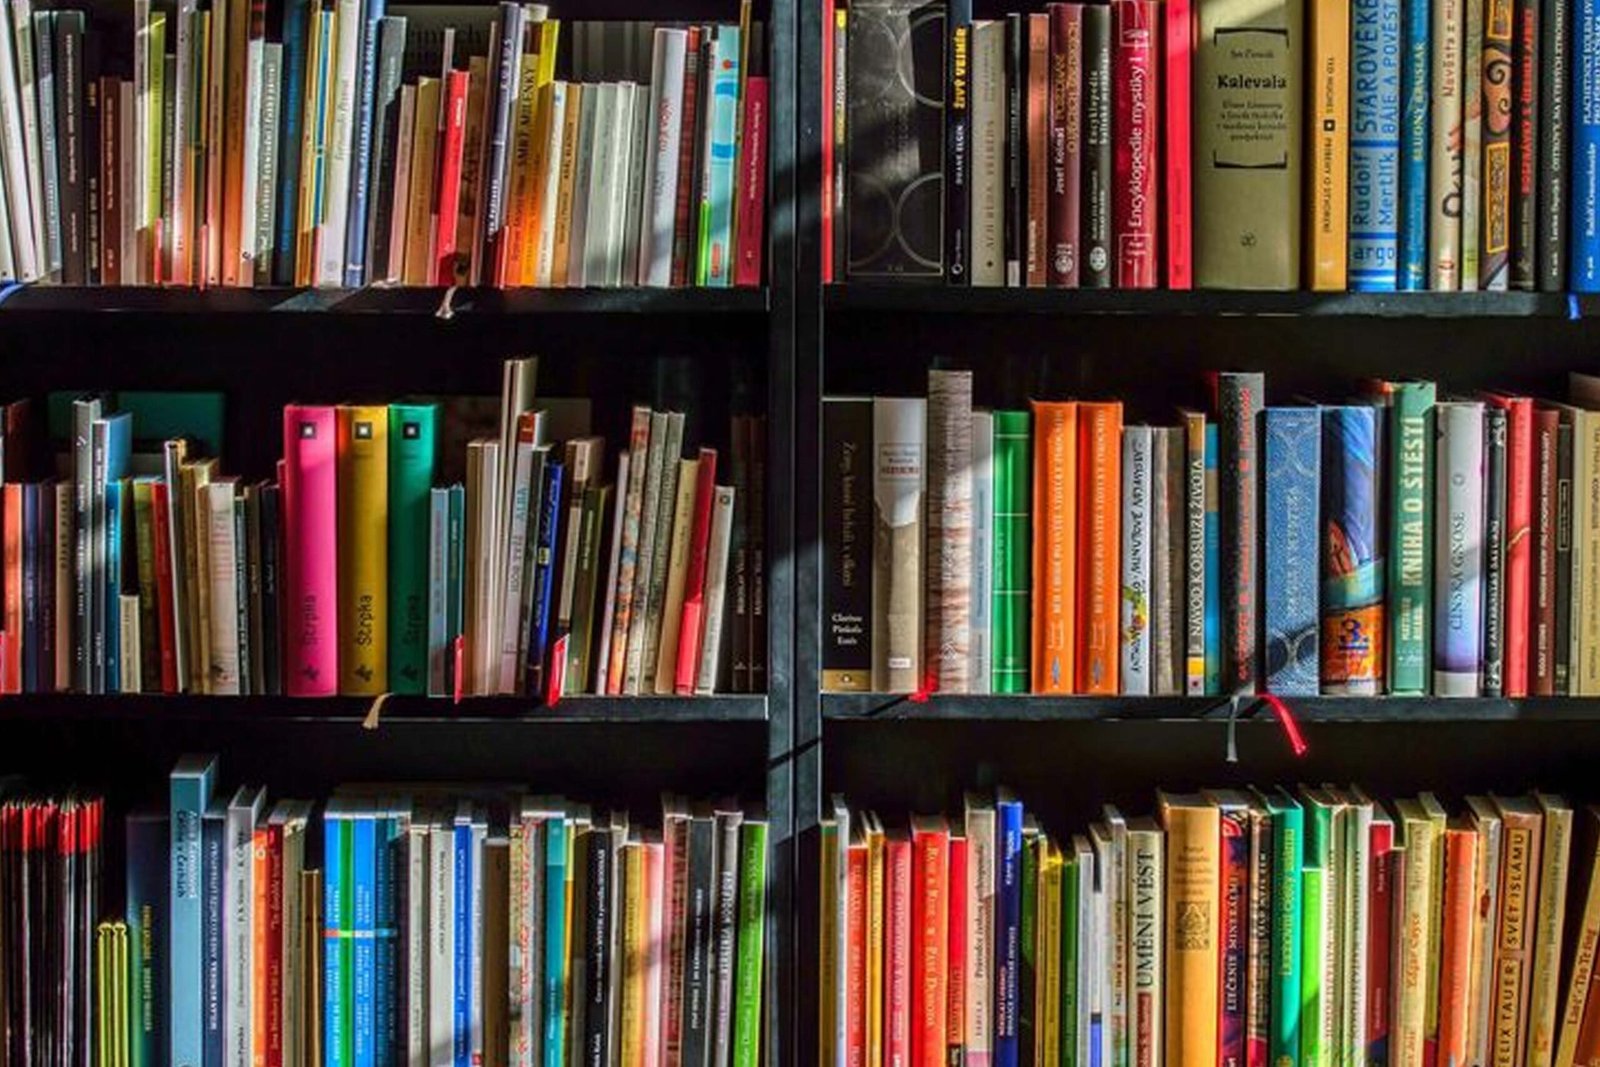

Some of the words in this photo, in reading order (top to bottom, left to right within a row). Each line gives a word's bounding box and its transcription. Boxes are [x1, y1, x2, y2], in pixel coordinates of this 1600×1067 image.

[1380, 2, 1397, 68] POVĚST
[1088, 70, 1100, 144] Encyklopedie
[1129, 66, 1145, 123] mystiky
[1216, 74, 1287, 90] Kalevala
[1383, 75, 1397, 86] A
[955, 124, 963, 152] ELGIN
[1379, 95, 1397, 133] BÁJE
[1055, 167, 1064, 194] Josef
[1128, 126, 1145, 227] Encyklopedie
[1353, 153, 1371, 225] Rudolf
[1377, 152, 1393, 225] Mertlík
[1353, 247, 1395, 267] argo
[1399, 417, 1422, 489] ŠTĚSTÍ
[1188, 459, 1202, 509] ŽIVOTA
[1403, 498, 1423, 513] O
[1402, 520, 1422, 585] KNIHA
[1451, 513, 1463, 569] GNOSE
[1189, 588, 1202, 636] NÁVOD
[1133, 848, 1152, 905] VÉST
[1508, 833, 1523, 899] ISLÁMU
[1133, 912, 1152, 986] UMĚNÍ
[1503, 906, 1518, 945] SVĚT
[1225, 954, 1237, 1011] LIEČENIE
[1501, 965, 1514, 1020] TAUER
[1498, 1029, 1511, 1067] ELIX
